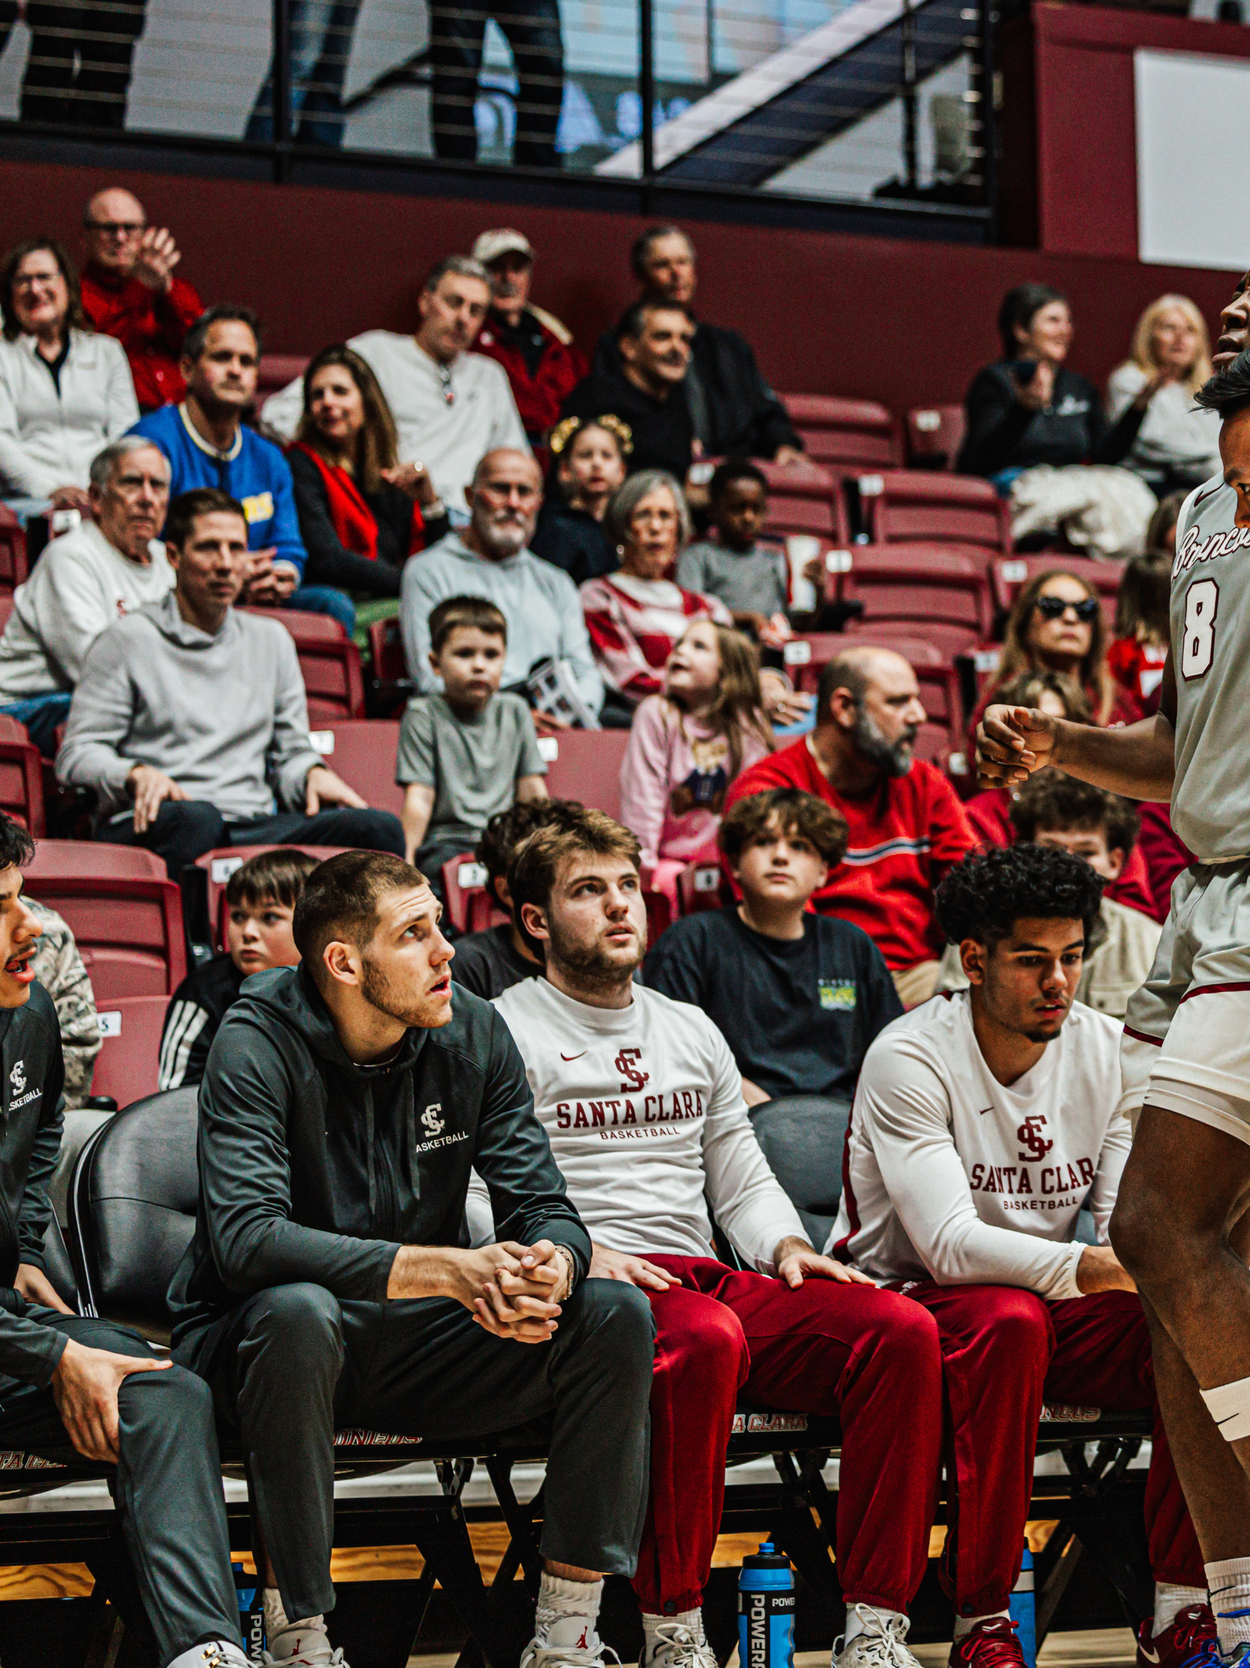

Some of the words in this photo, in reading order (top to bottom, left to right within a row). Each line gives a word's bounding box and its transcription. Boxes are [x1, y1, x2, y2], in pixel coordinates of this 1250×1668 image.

[1182, 577, 1220, 682] 8
[9, 1088, 43, 1111] SKETBALL
[556, 1099, 637, 1129] SANTA
[600, 1126, 681, 1140] BASKETBALL
[970, 1163, 1033, 1195] SANTA
[1004, 1196, 1079, 1210] BASKETBALL
